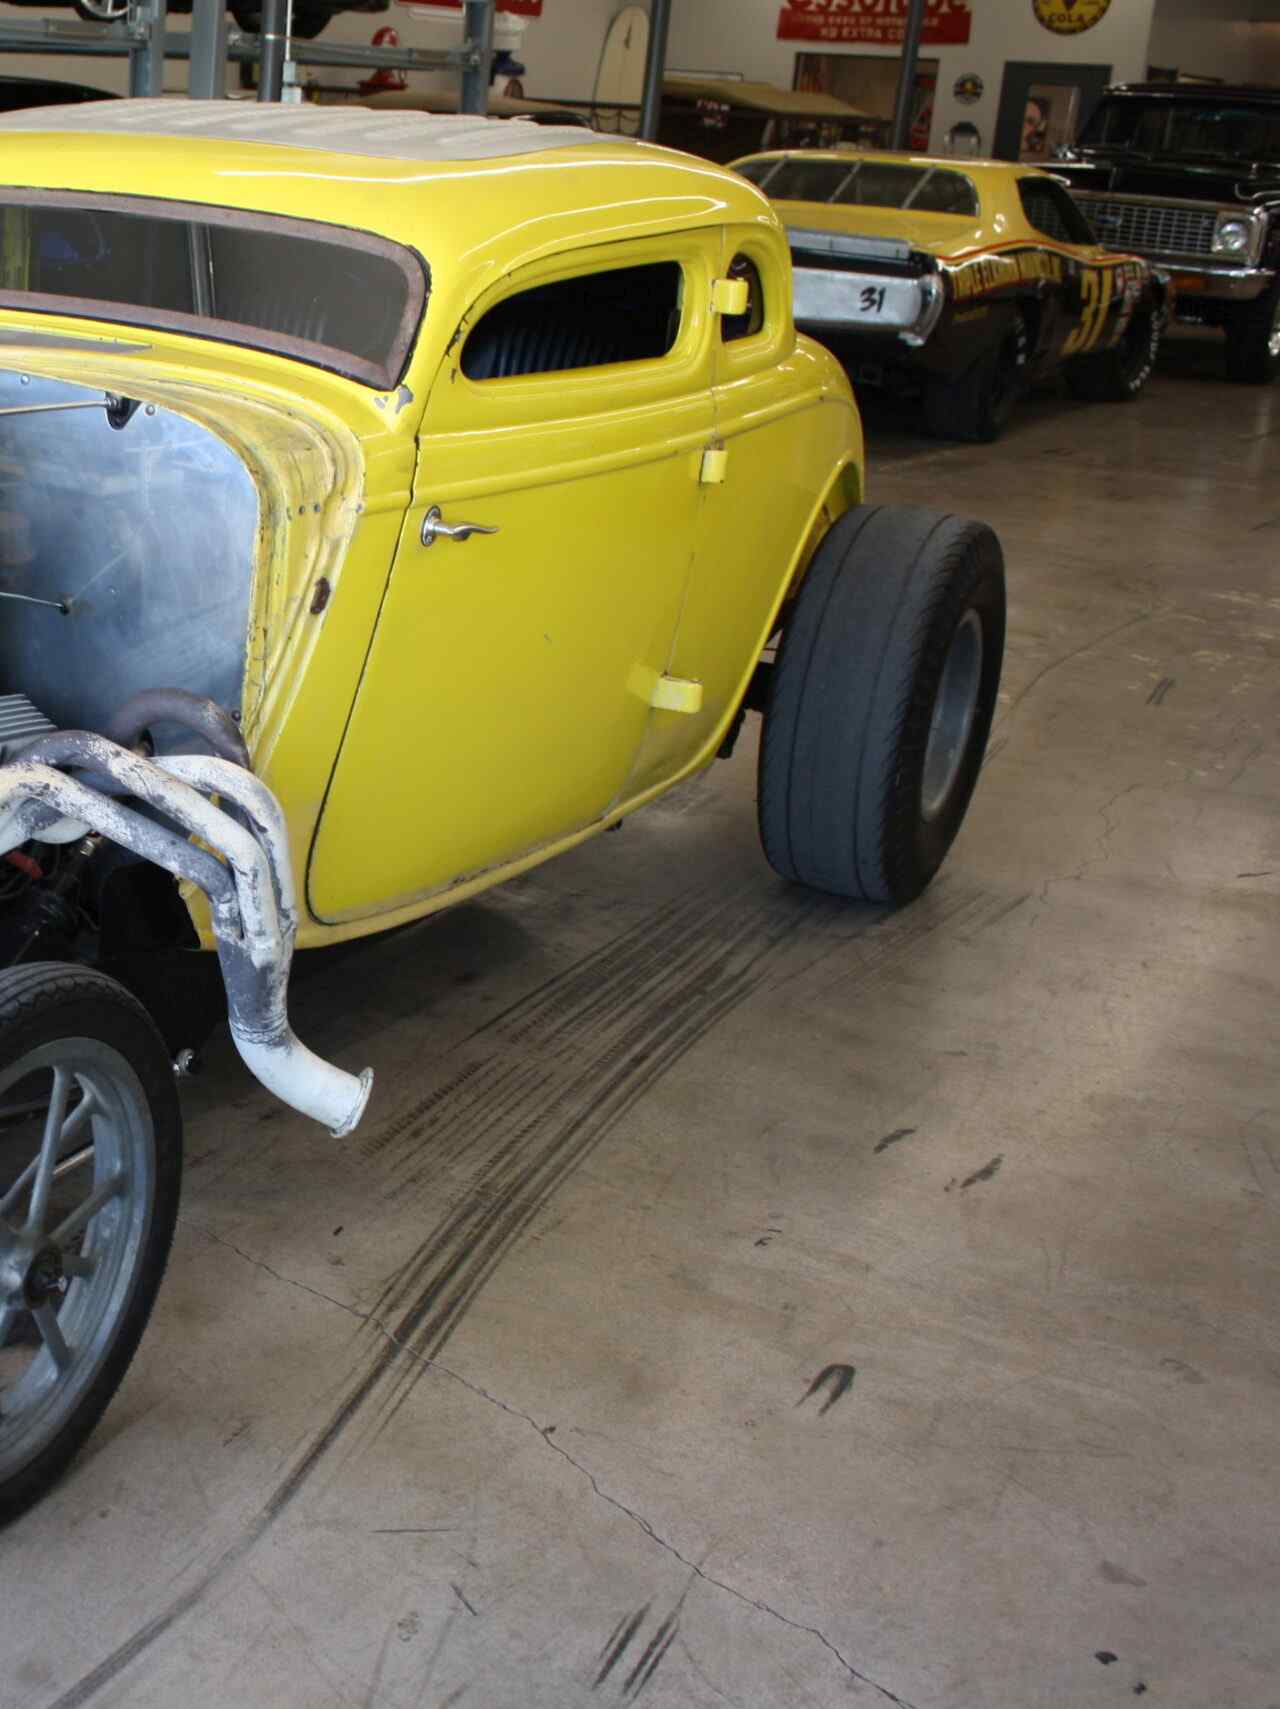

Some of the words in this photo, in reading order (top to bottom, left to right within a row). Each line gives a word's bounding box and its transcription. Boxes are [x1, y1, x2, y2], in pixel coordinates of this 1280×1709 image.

[1049, 12, 1087, 24] COLA
[842, 27, 882, 39] EXTRA
[859, 285, 886, 314] 31
